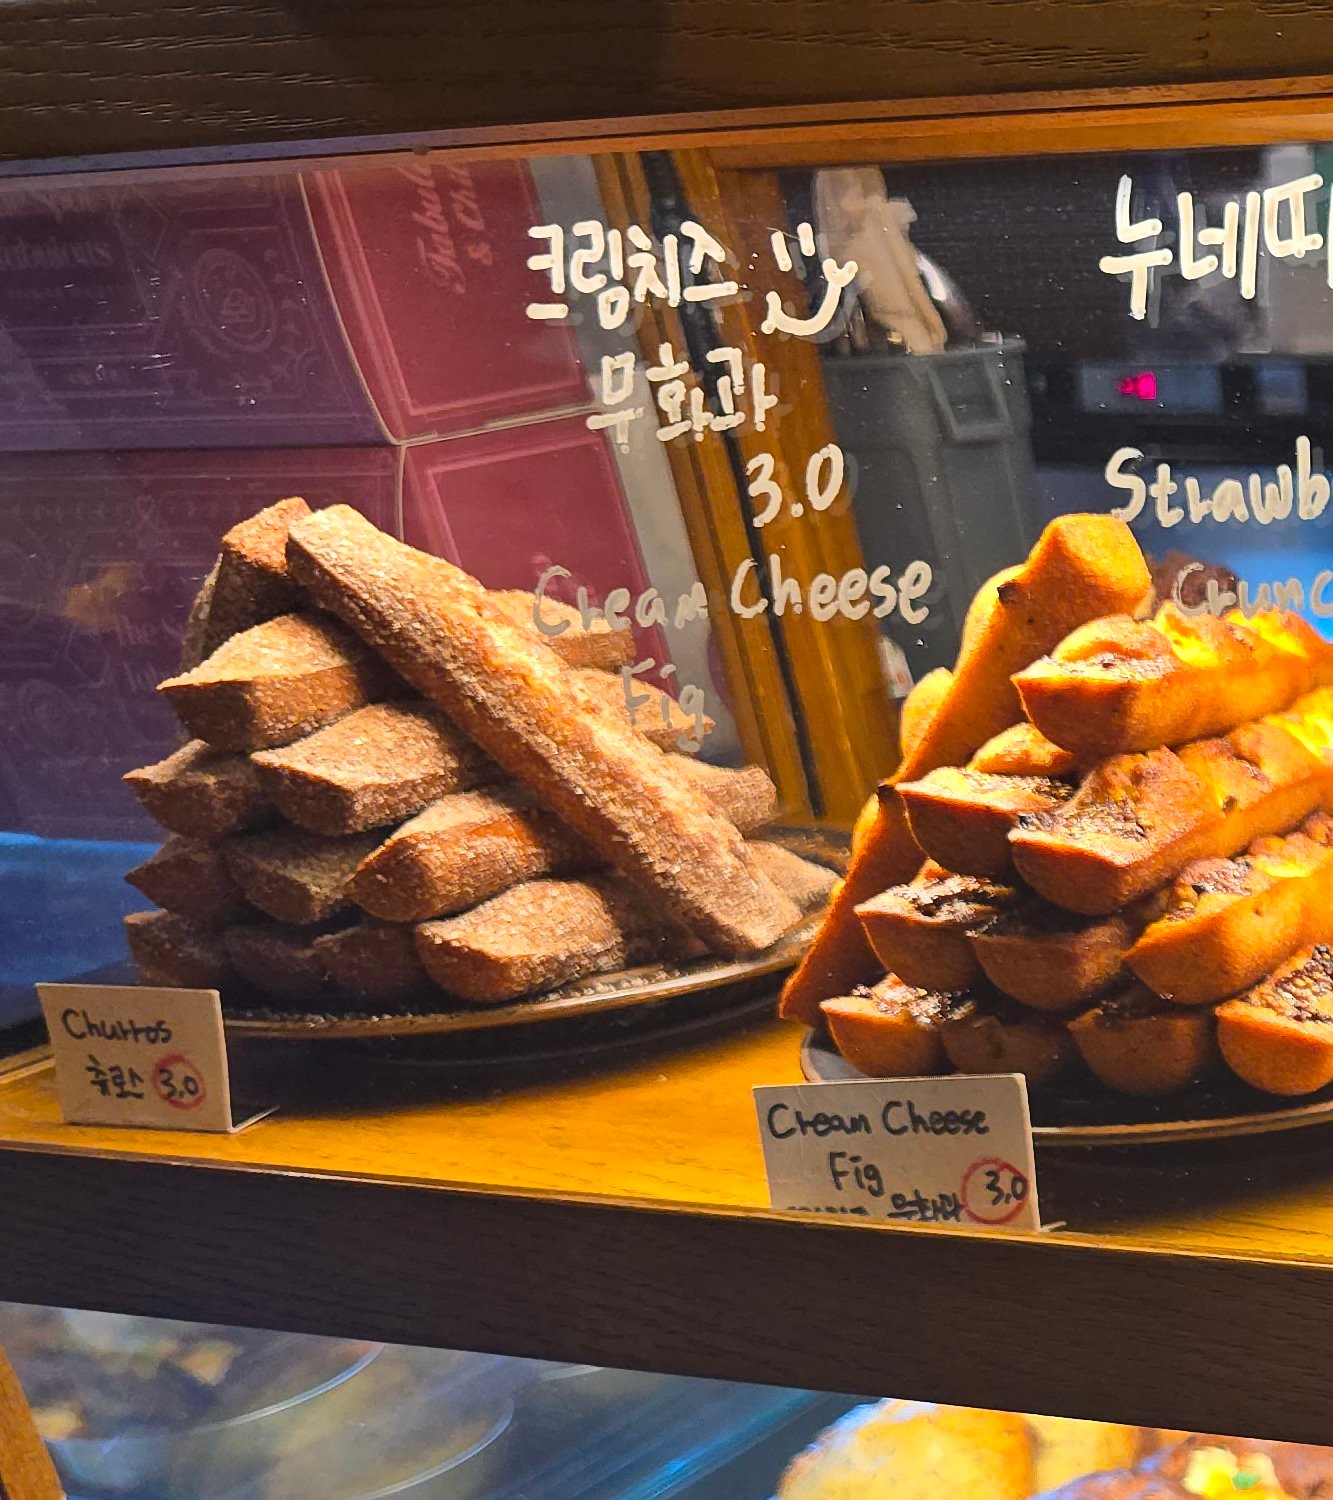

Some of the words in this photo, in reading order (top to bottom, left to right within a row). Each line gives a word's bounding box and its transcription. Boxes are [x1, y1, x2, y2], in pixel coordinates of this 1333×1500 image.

[525, 221, 737, 330] 크림치즈
[587, 344, 779, 453] 무화과
[746, 446, 845, 526] 3.0
[533, 565, 708, 636] Cream
[731, 553, 934, 624] Cheese
[621, 657, 705, 753] Fig
[61, 1008, 173, 1044] Churros
[159, 1068, 200, 1098] 3.0
[767, 1103, 872, 1139] Cream
[882, 1100, 990, 1136] Cheese
[829, 1151, 885, 1198] Fig
[985, 1171, 1027, 1206] 3.0
